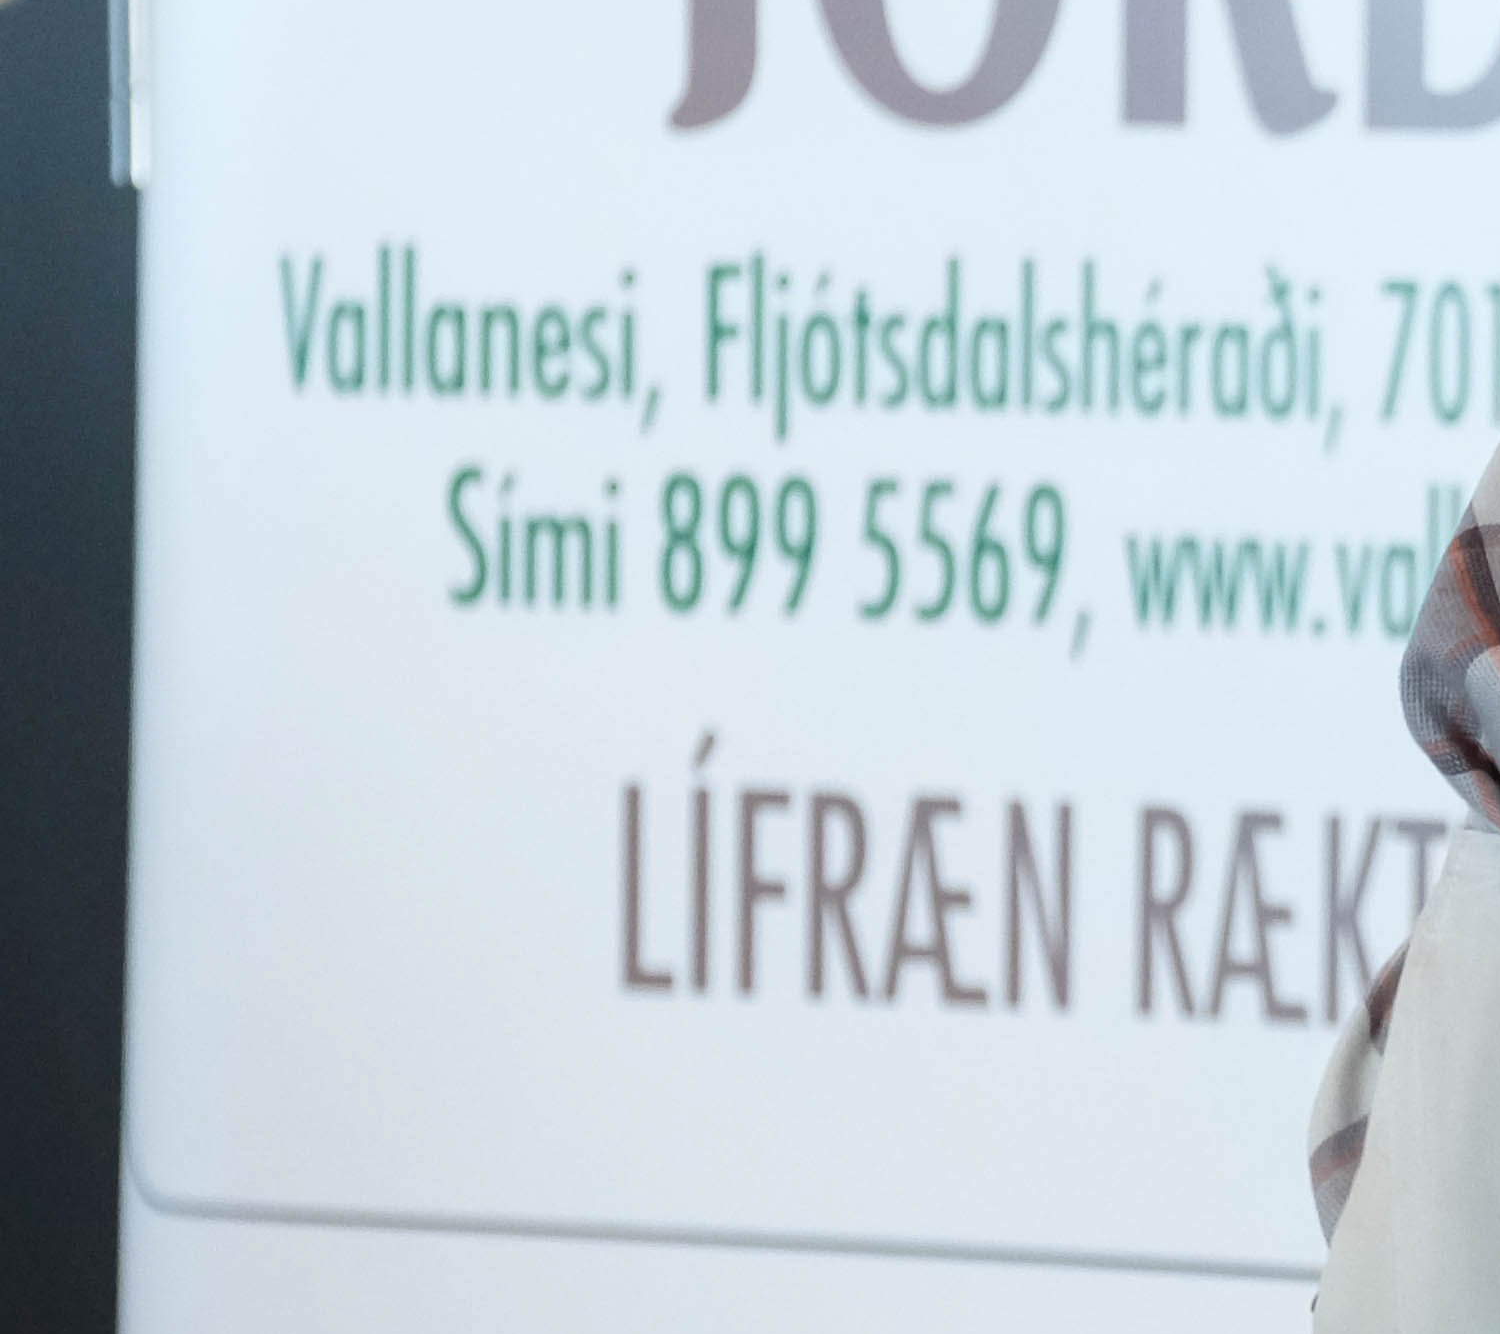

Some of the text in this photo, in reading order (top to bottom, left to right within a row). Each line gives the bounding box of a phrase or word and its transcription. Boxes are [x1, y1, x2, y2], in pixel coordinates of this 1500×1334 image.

[280, 242, 662, 431] Vallanesi,
[704, 247, 1340, 455] Fljótsdalshéraði,
[446, 465, 1464, 657] Sími 899 5569, www.val
[620, 729, 1075, 1013] LÍFRÆN
